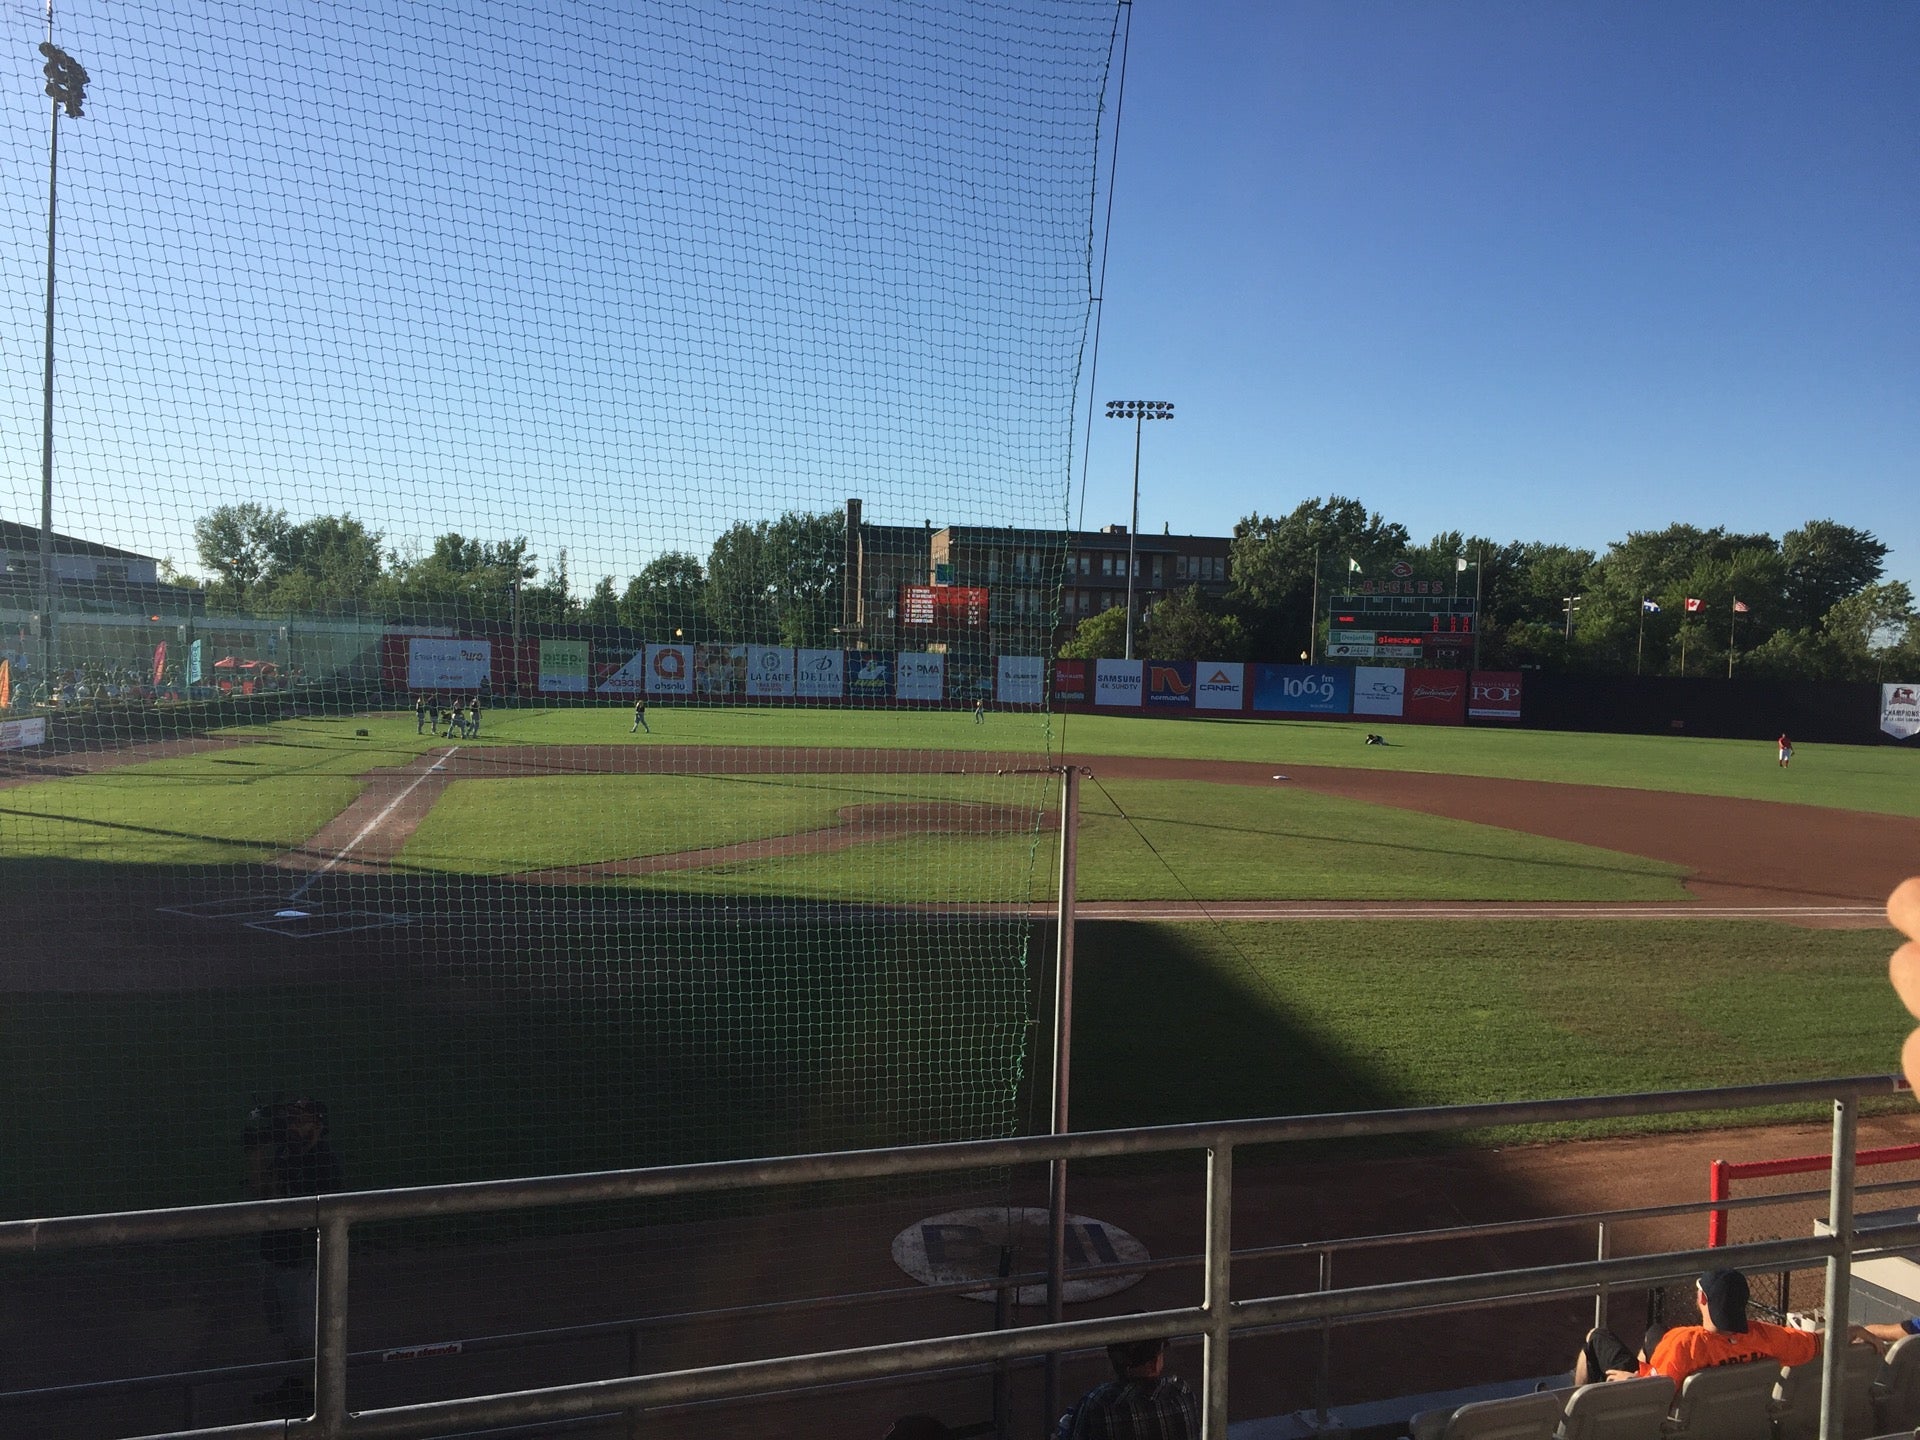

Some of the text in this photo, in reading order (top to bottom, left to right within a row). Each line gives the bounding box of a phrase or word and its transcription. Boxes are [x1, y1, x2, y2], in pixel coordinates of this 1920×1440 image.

[800, 671, 840, 682] DELTA
[1097, 674, 1141, 683] SAMSUNG
[655, 682, 685, 690] absolu
[1200, 684, 1240, 692] CANAC
[1471, 687, 1520, 701] POP
